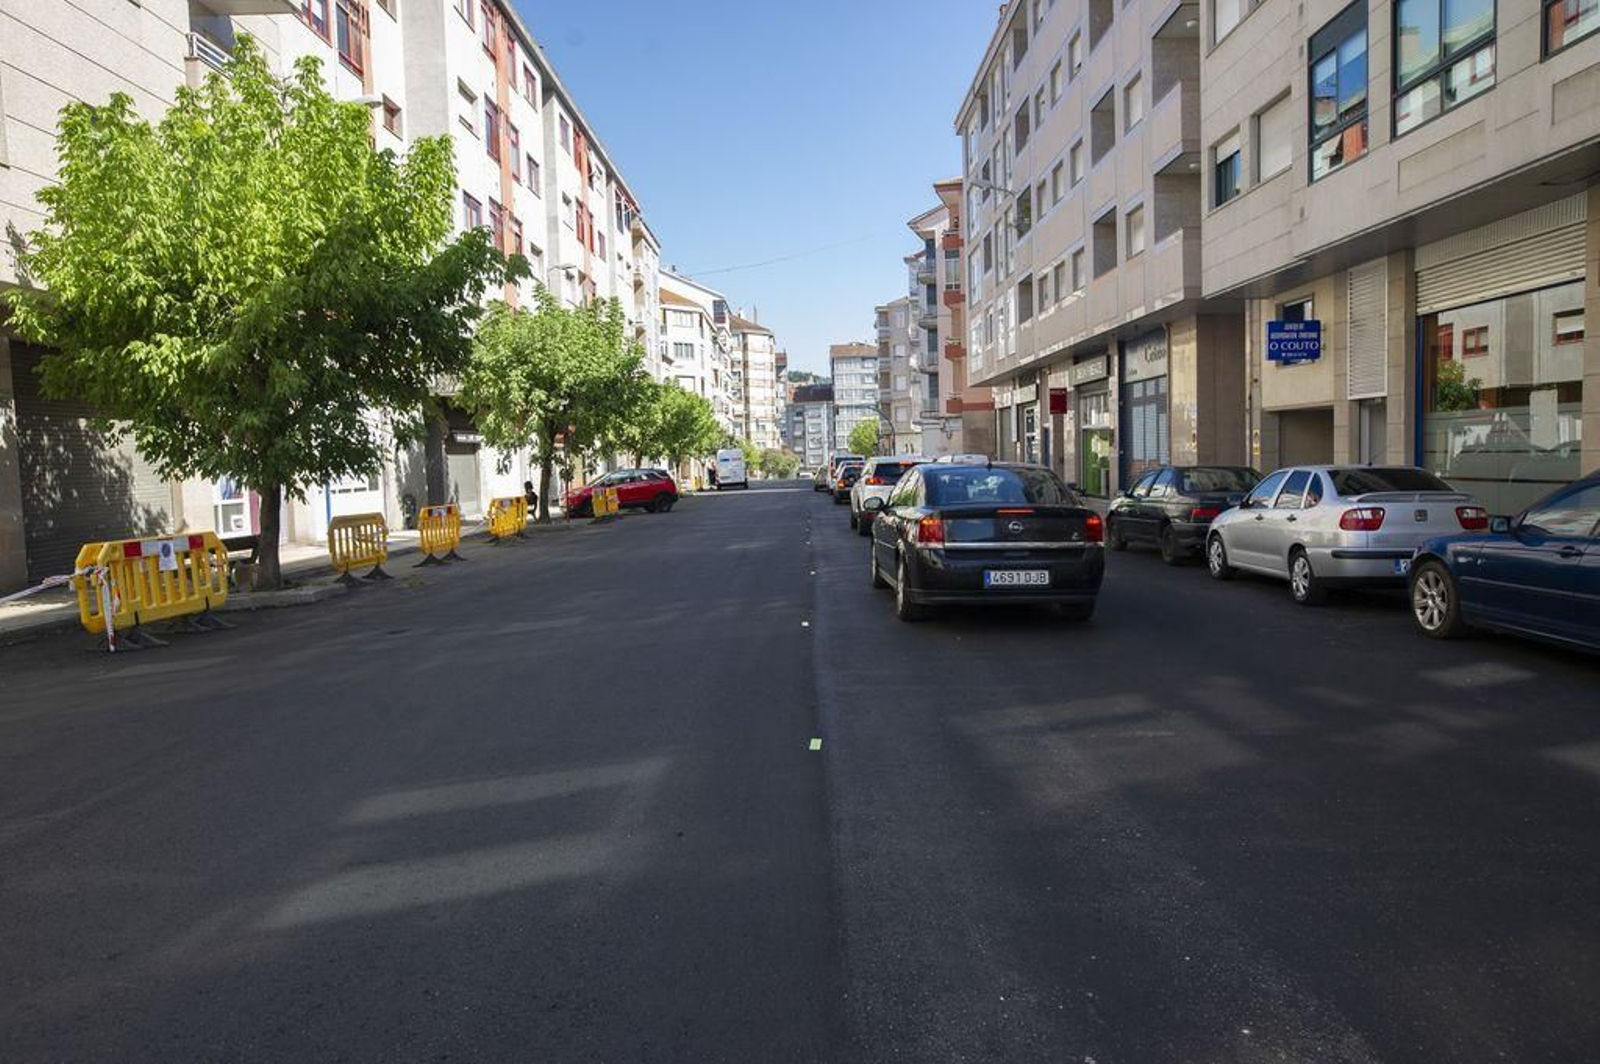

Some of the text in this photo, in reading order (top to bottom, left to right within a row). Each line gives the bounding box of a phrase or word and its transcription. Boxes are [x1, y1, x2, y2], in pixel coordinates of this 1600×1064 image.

[1269, 341, 1319, 350] O COUTO
[992, 572, 1021, 583] 4691
